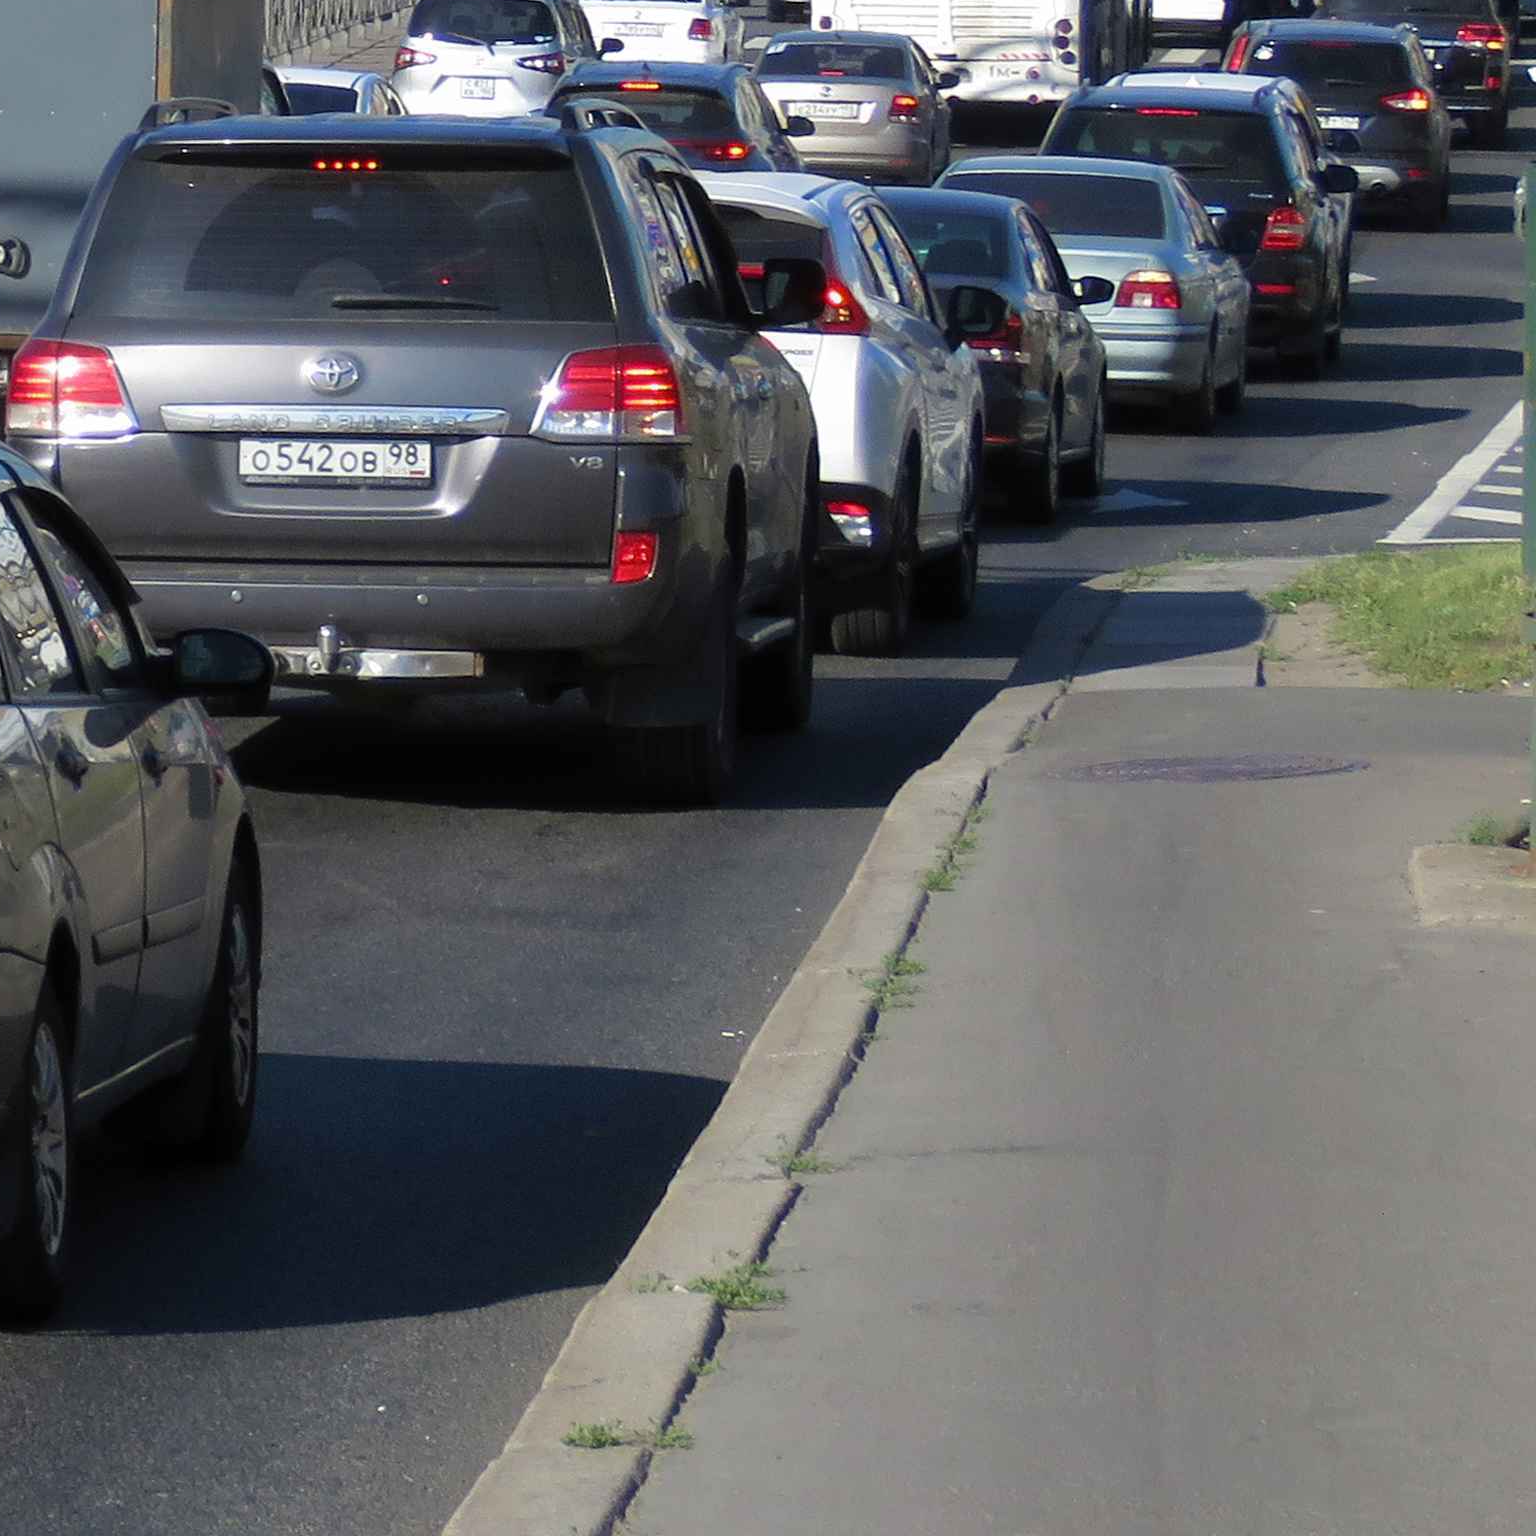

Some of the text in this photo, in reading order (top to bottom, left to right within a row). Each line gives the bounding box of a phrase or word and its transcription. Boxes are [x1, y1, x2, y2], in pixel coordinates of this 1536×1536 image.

[208, 415, 458, 433] LAND CRUISER
[251, 443, 418, 473] О542ОВ 98
[569, 456, 603, 469] V8
